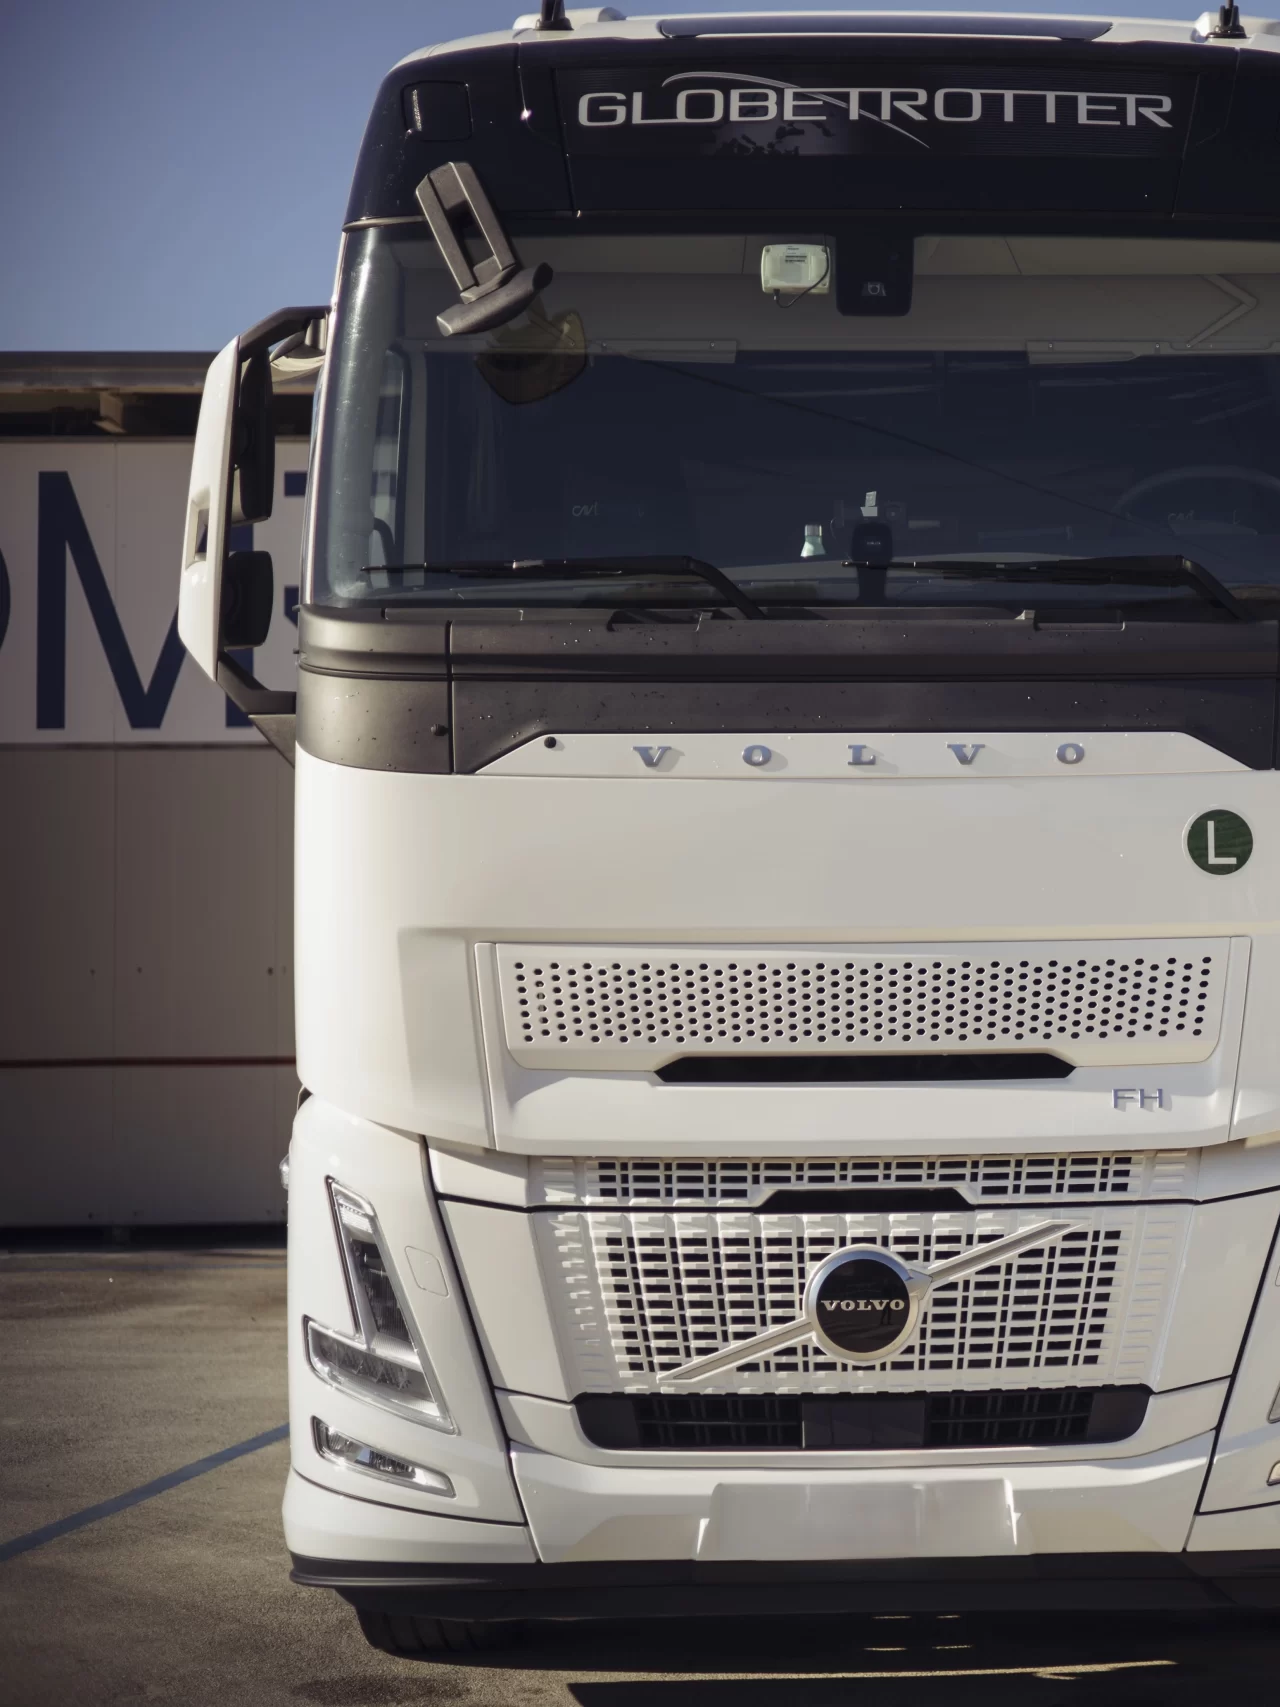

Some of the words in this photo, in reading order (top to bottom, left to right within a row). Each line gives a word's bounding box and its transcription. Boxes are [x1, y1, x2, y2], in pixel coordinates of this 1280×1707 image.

[578, 87, 1173, 128] GLOBETROTTER
[632, 742, 1086, 768] VOLVO
[1206, 820, 1238, 865] L
[1111, 1087, 1164, 1109] FH
[820, 1298, 906, 1312] VOLVO
